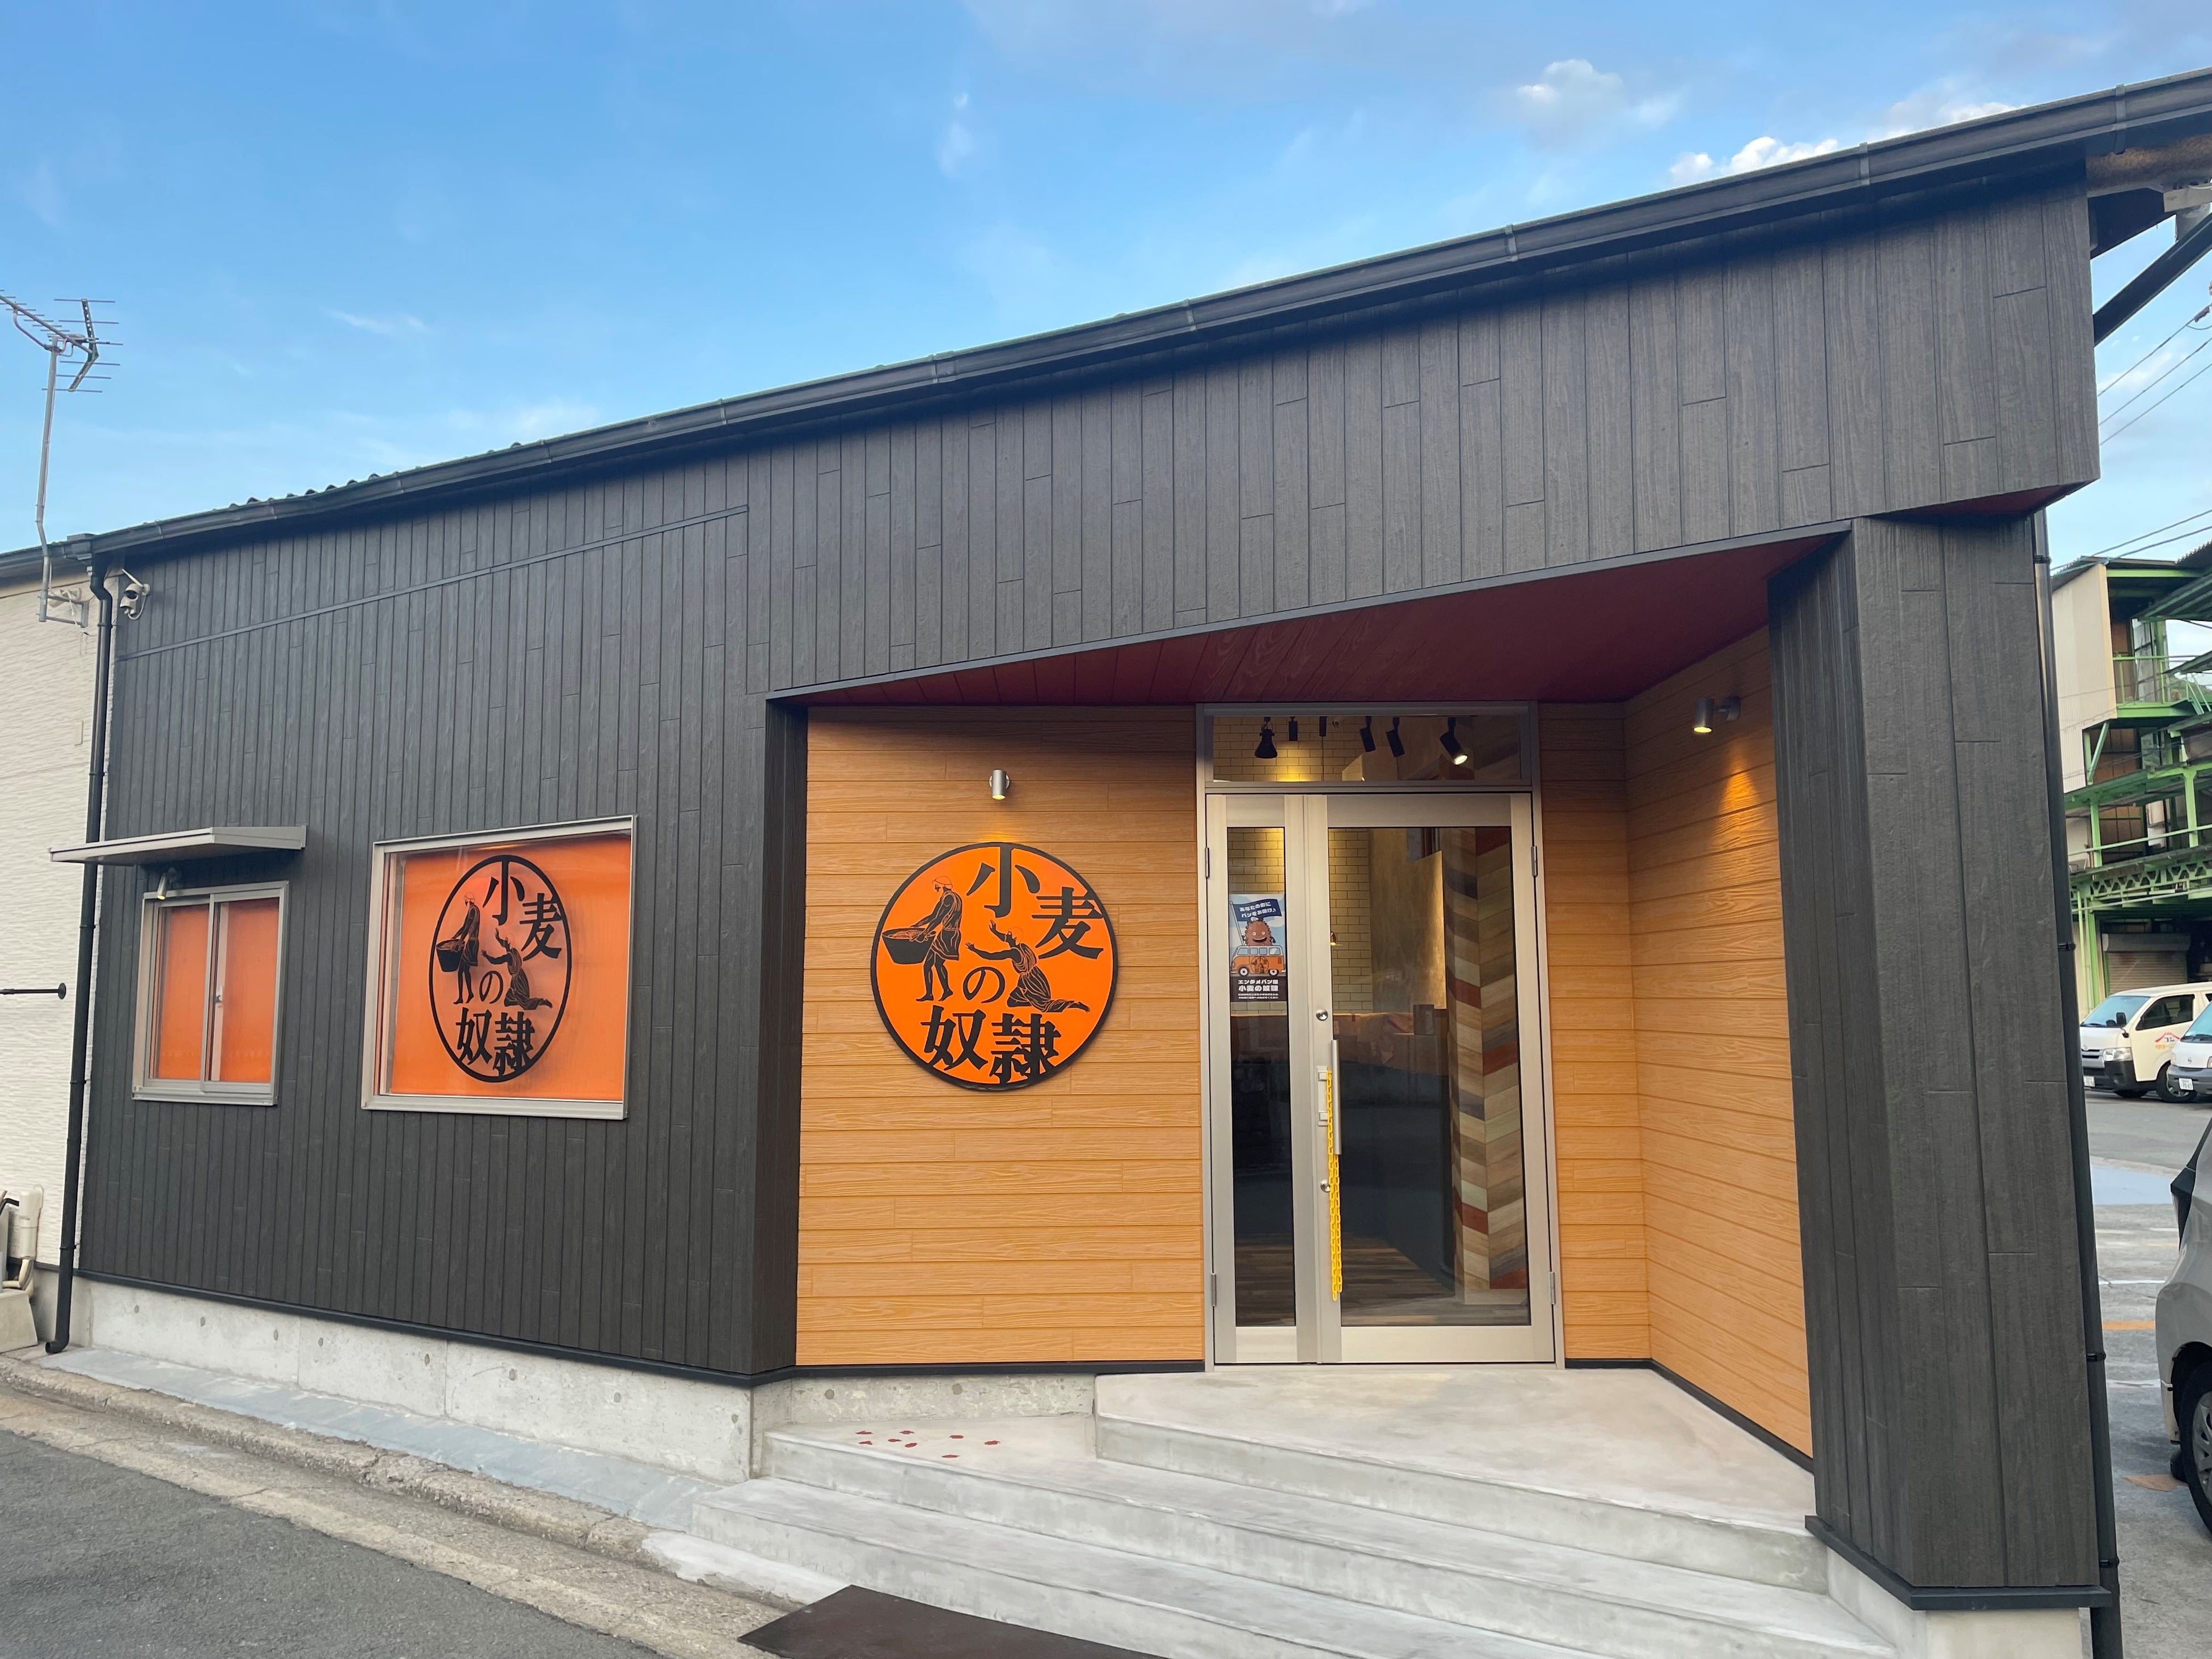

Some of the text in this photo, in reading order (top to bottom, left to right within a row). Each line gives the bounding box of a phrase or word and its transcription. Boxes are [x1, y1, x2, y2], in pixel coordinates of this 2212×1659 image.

[482, 858, 563, 961] 小麦
[965, 846, 1104, 960] 小麦
[479, 970, 504, 1004] の
[963, 966, 1006, 1004] の
[455, 1007, 535, 1078] 奴隷
[921, 1005, 1062, 1084] 奴隷
